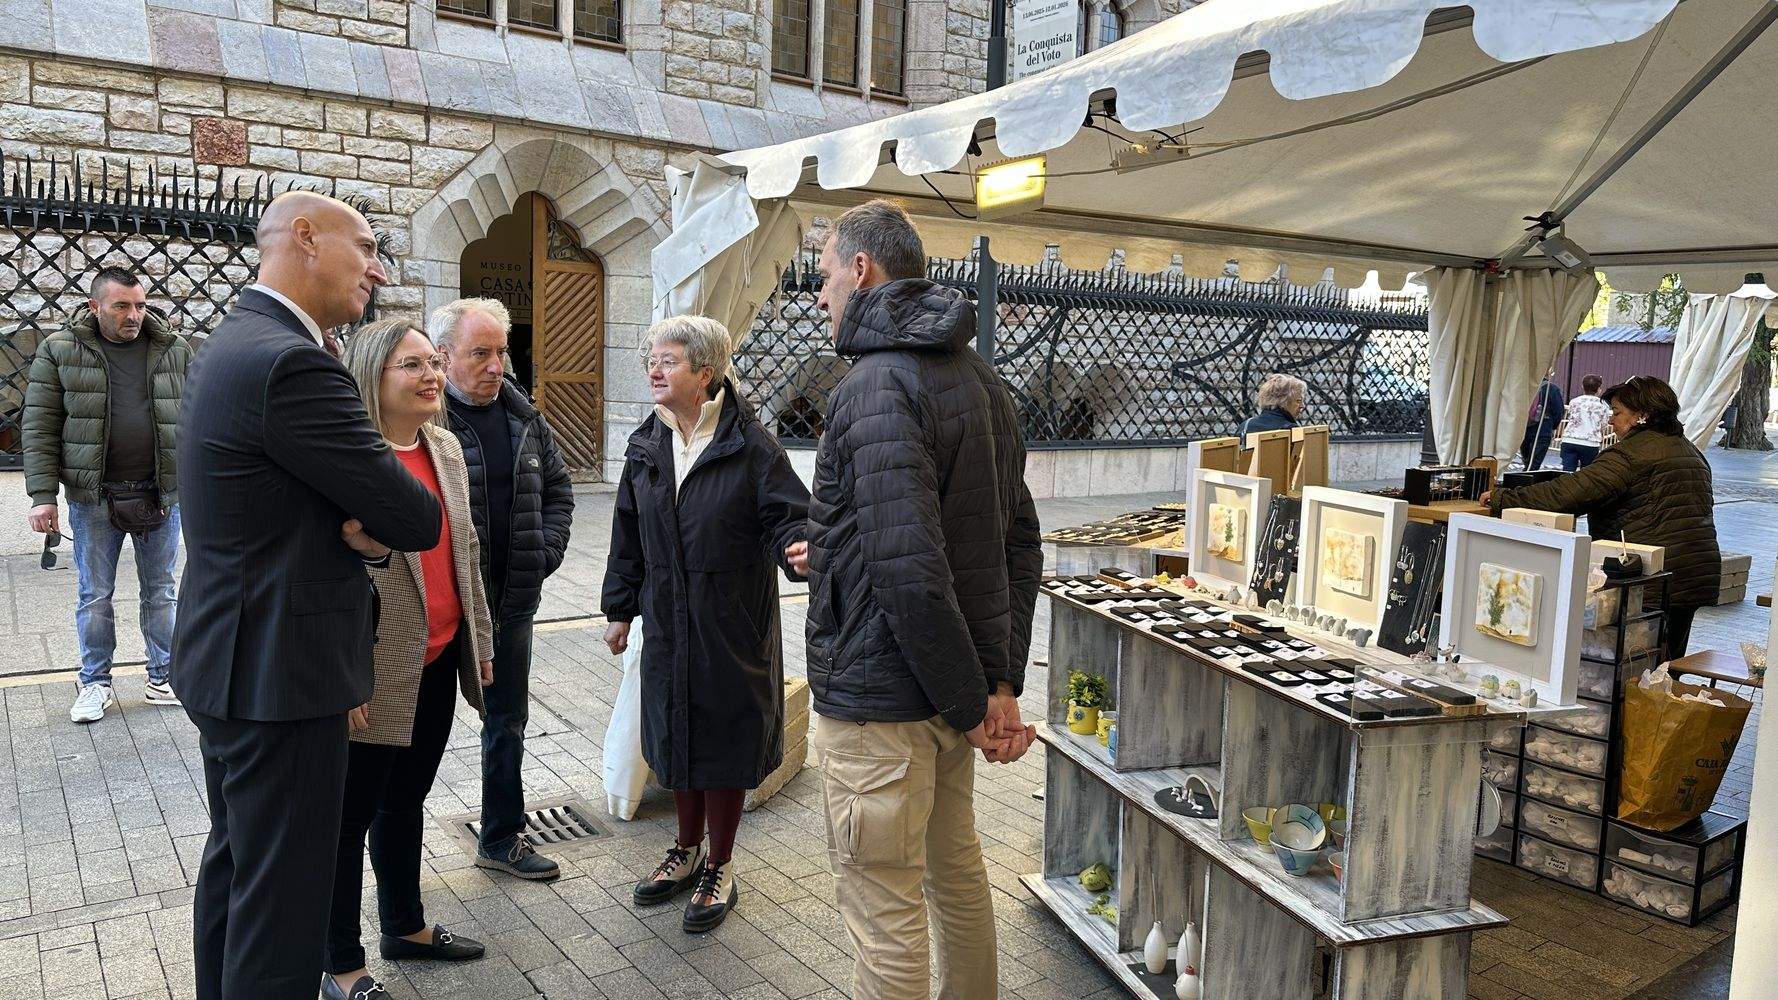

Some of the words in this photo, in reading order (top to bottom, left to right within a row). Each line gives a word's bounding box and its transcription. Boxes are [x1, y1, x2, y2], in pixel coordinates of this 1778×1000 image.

[1017, 44, 1027, 56] La
[1029, 33, 1072, 51] Conquista
[1026, 52, 1040, 67] del
[1041, 50, 1061, 62] Voto
[480, 262, 522, 271] MUSEO
[480, 276, 524, 292] CASA
